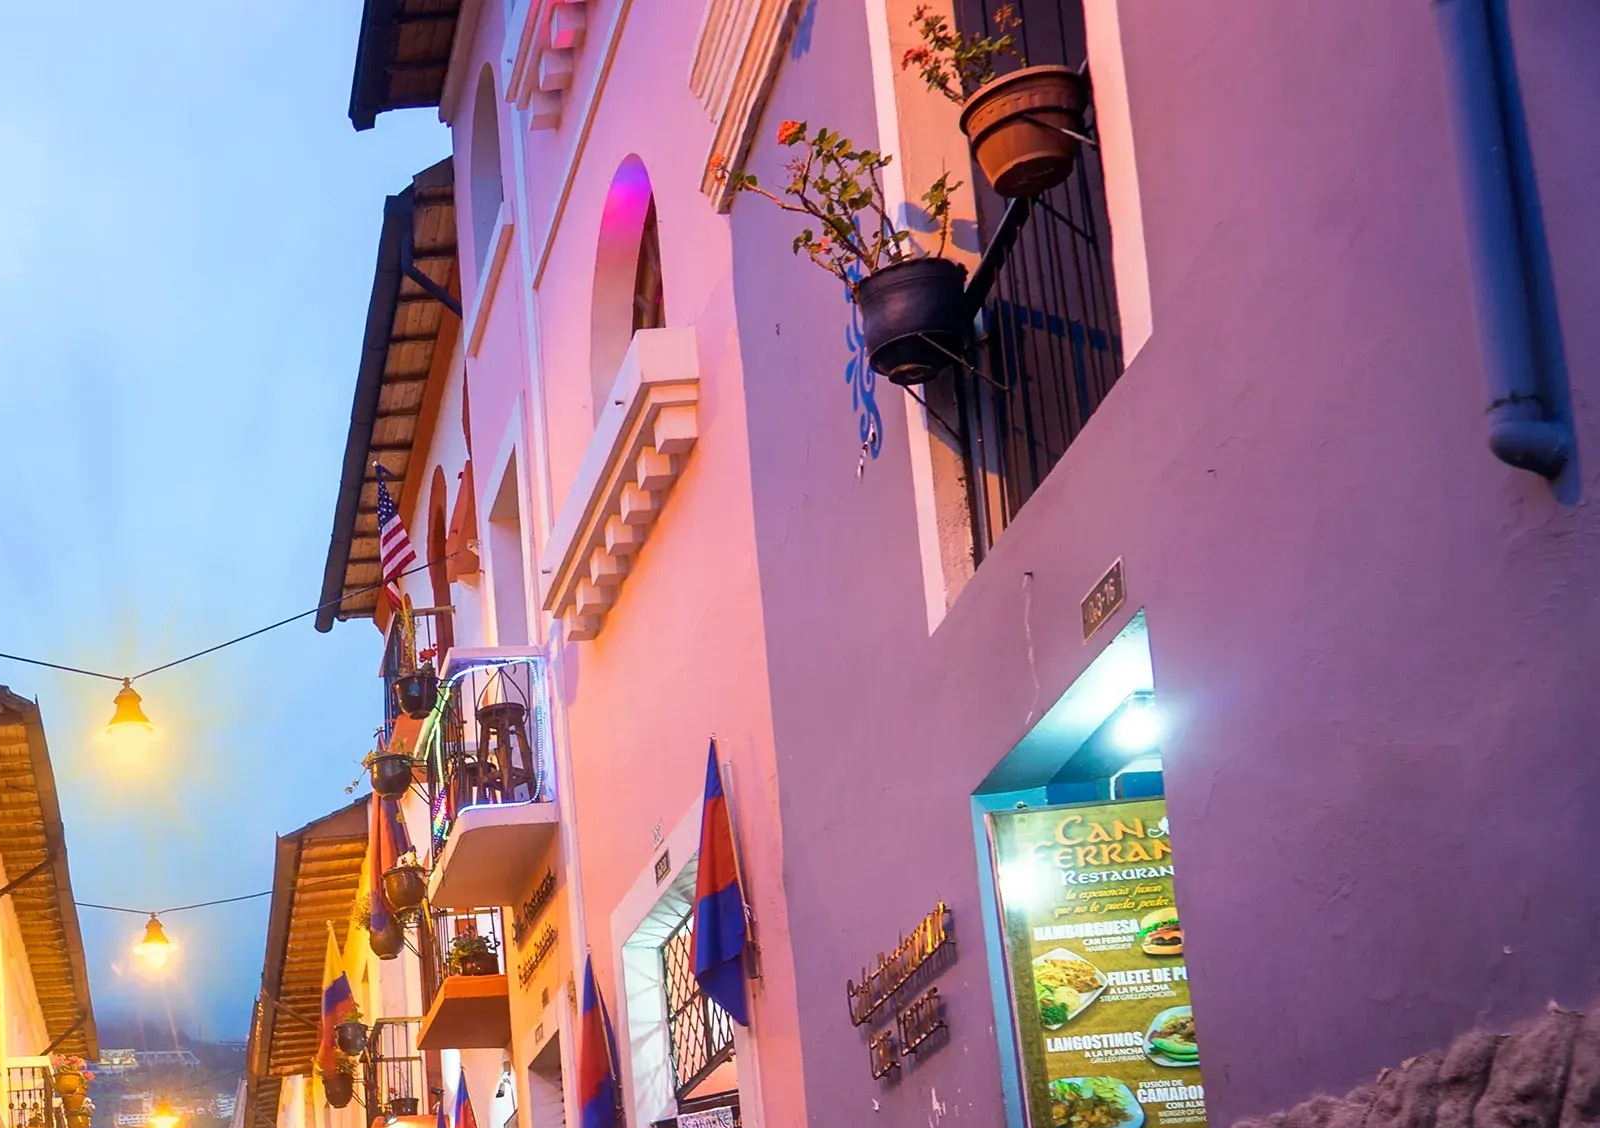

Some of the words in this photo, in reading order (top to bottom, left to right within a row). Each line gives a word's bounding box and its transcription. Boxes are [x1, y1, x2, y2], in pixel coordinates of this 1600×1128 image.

[1054, 815, 1145, 846] CAN
[1075, 905, 1087, 914] no
[1082, 938, 1101, 946] CAN
[1101, 936, 1135, 944] FERRAN
[1107, 971, 1150, 986] FILETE
[1152, 968, 1171, 983] DE
[1130, 984, 1169, 994] PLANCHA
[1046, 1031, 1143, 1052] LANGOSTINOS
[1092, 1050, 1103, 1058] LA
[1104, 1047, 1143, 1057] PLANCHA
[1090, 1056, 1117, 1064] GRILLED
[1172, 1079, 1184, 1087] DE
[1166, 1101, 1184, 1109] CON
